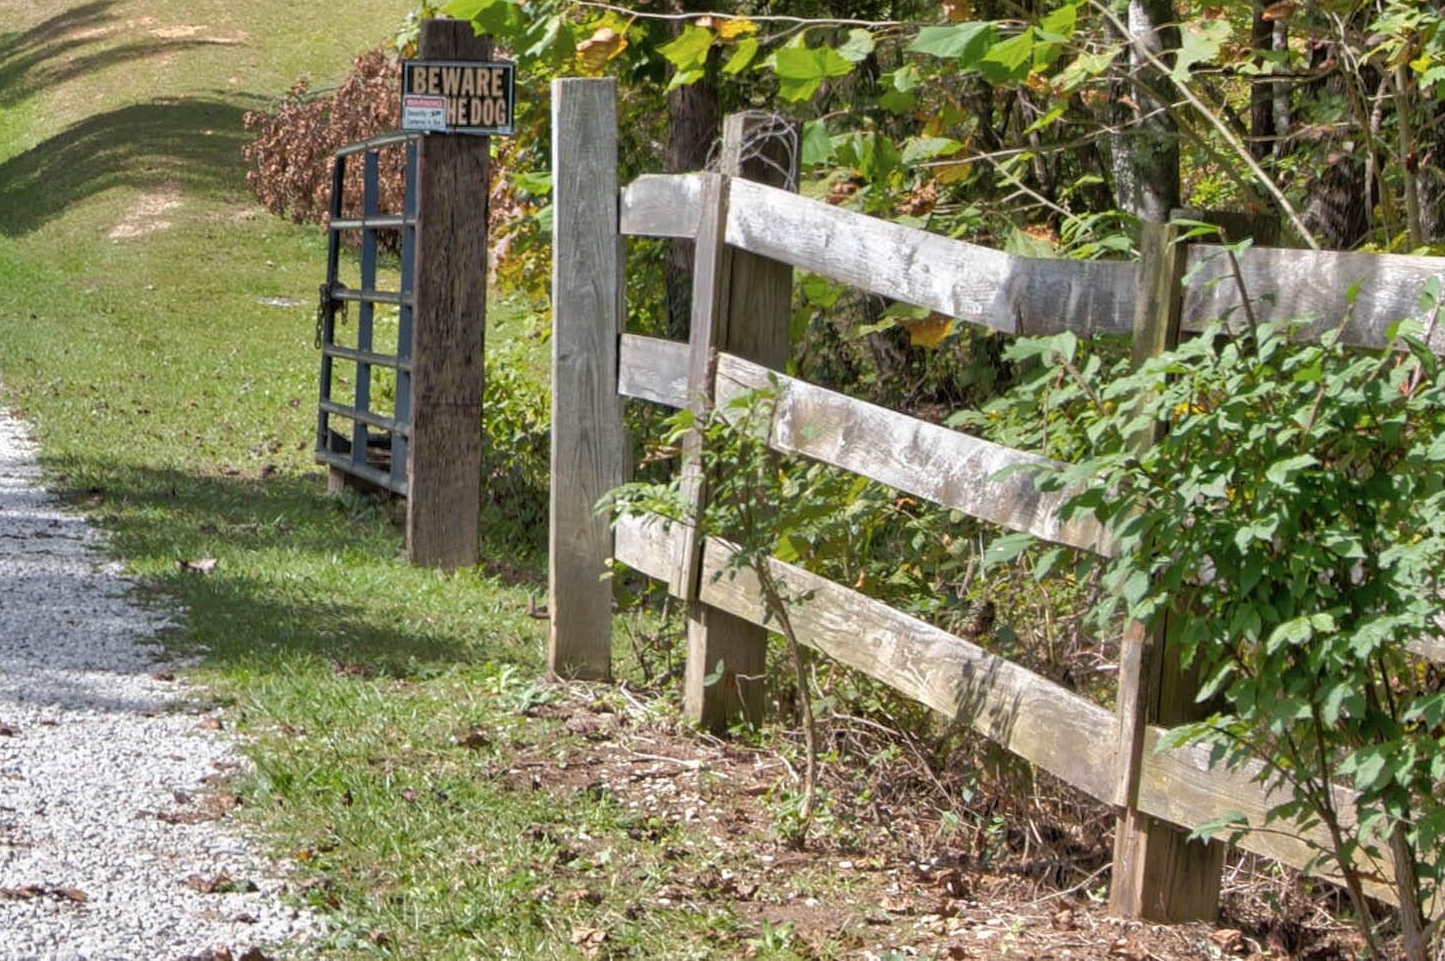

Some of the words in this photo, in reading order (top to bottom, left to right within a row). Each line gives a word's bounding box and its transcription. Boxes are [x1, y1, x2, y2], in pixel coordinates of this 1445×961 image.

[413, 67, 504, 96] BEWARE
[446, 97, 467, 125] HE
[470, 99, 506, 126] DOG
